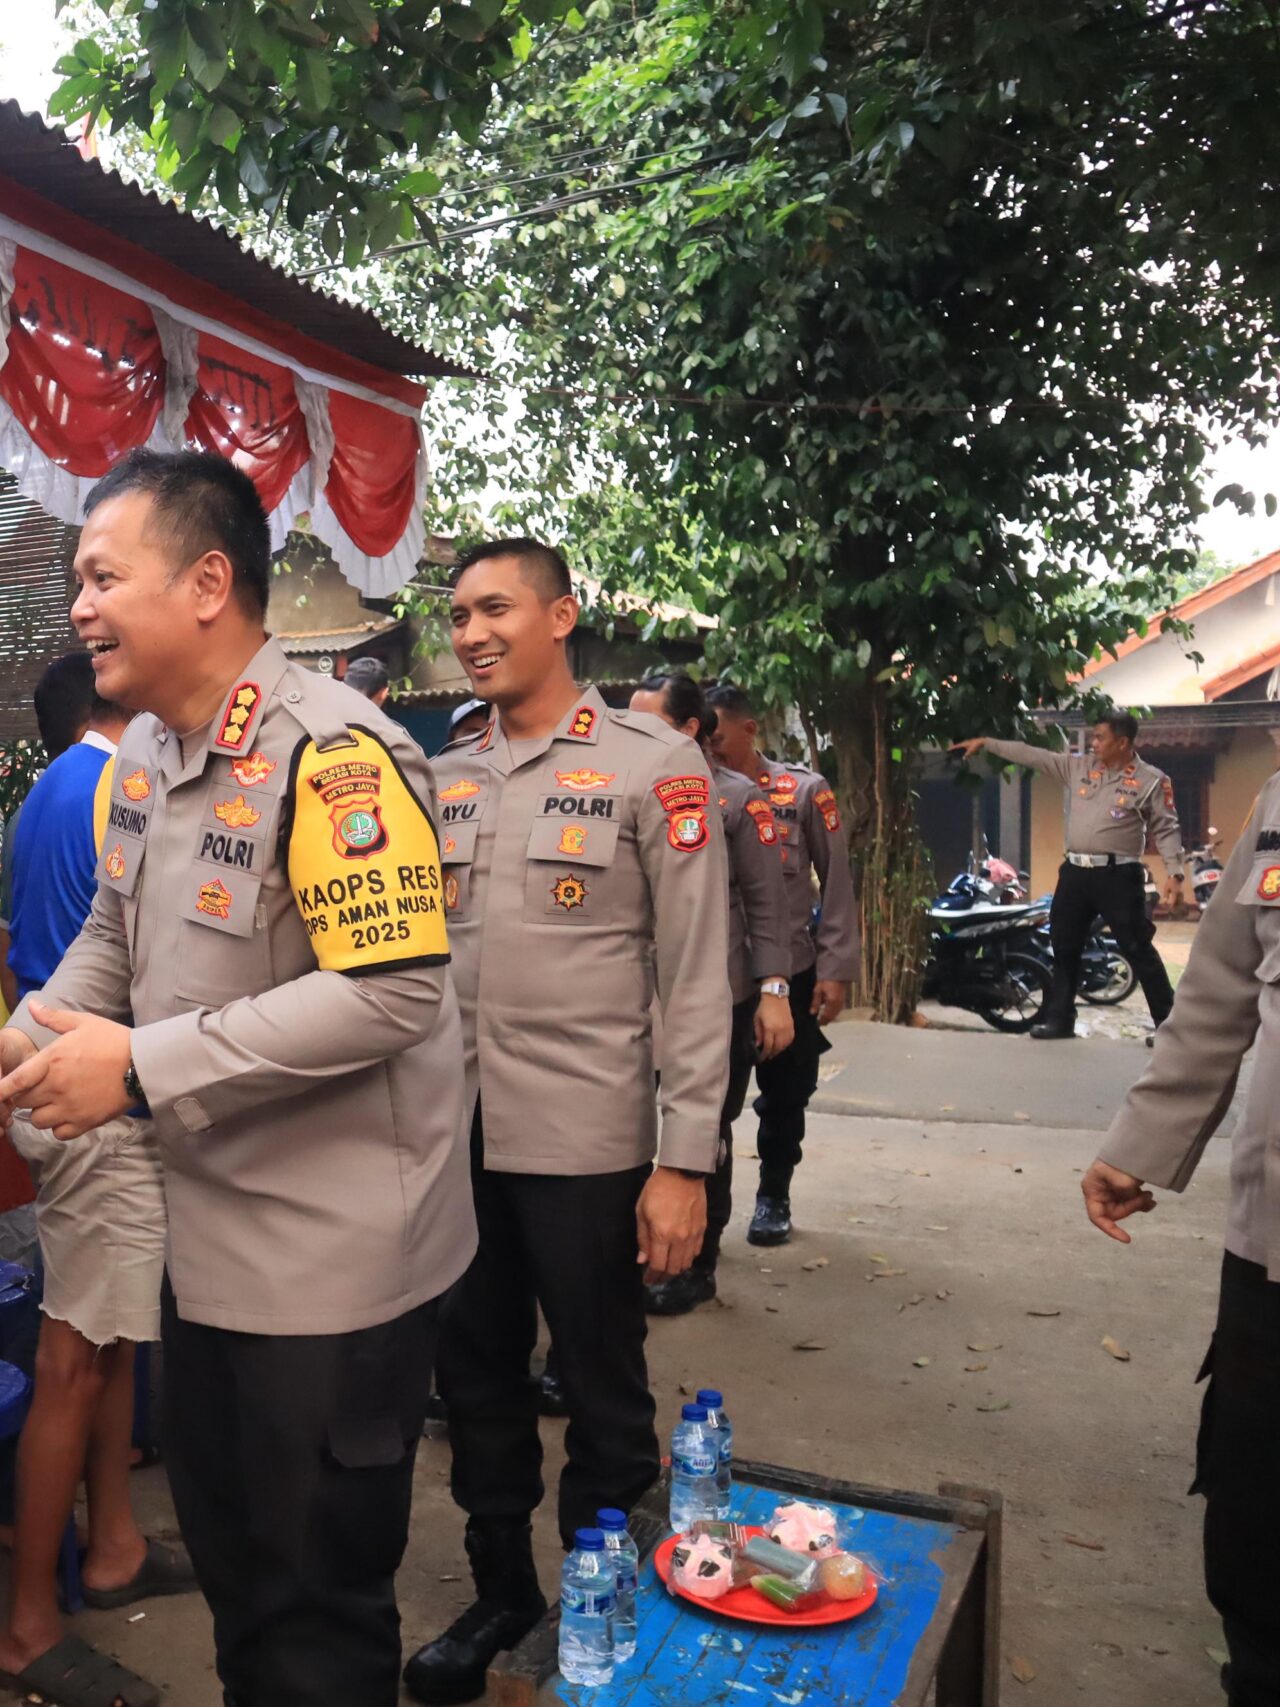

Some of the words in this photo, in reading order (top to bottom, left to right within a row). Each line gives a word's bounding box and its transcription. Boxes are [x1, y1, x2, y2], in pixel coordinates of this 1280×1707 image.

[312, 765, 347, 784] POLRES
[348, 763, 377, 773] METRO
[350, 769, 372, 777] KOTA
[325, 784, 354, 801] METRO
[355, 782, 376, 793] JAYA
[108, 803, 147, 836] KUSUMO
[543, 797, 614, 818] POLRI
[200, 831, 255, 869] POLRI
[298, 868, 386, 914] KAOPS
[397, 864, 439, 891] RES
[338, 899, 390, 928] AMAN
[396, 895, 437, 915] NUSA
[350, 919, 412, 950] 2025
